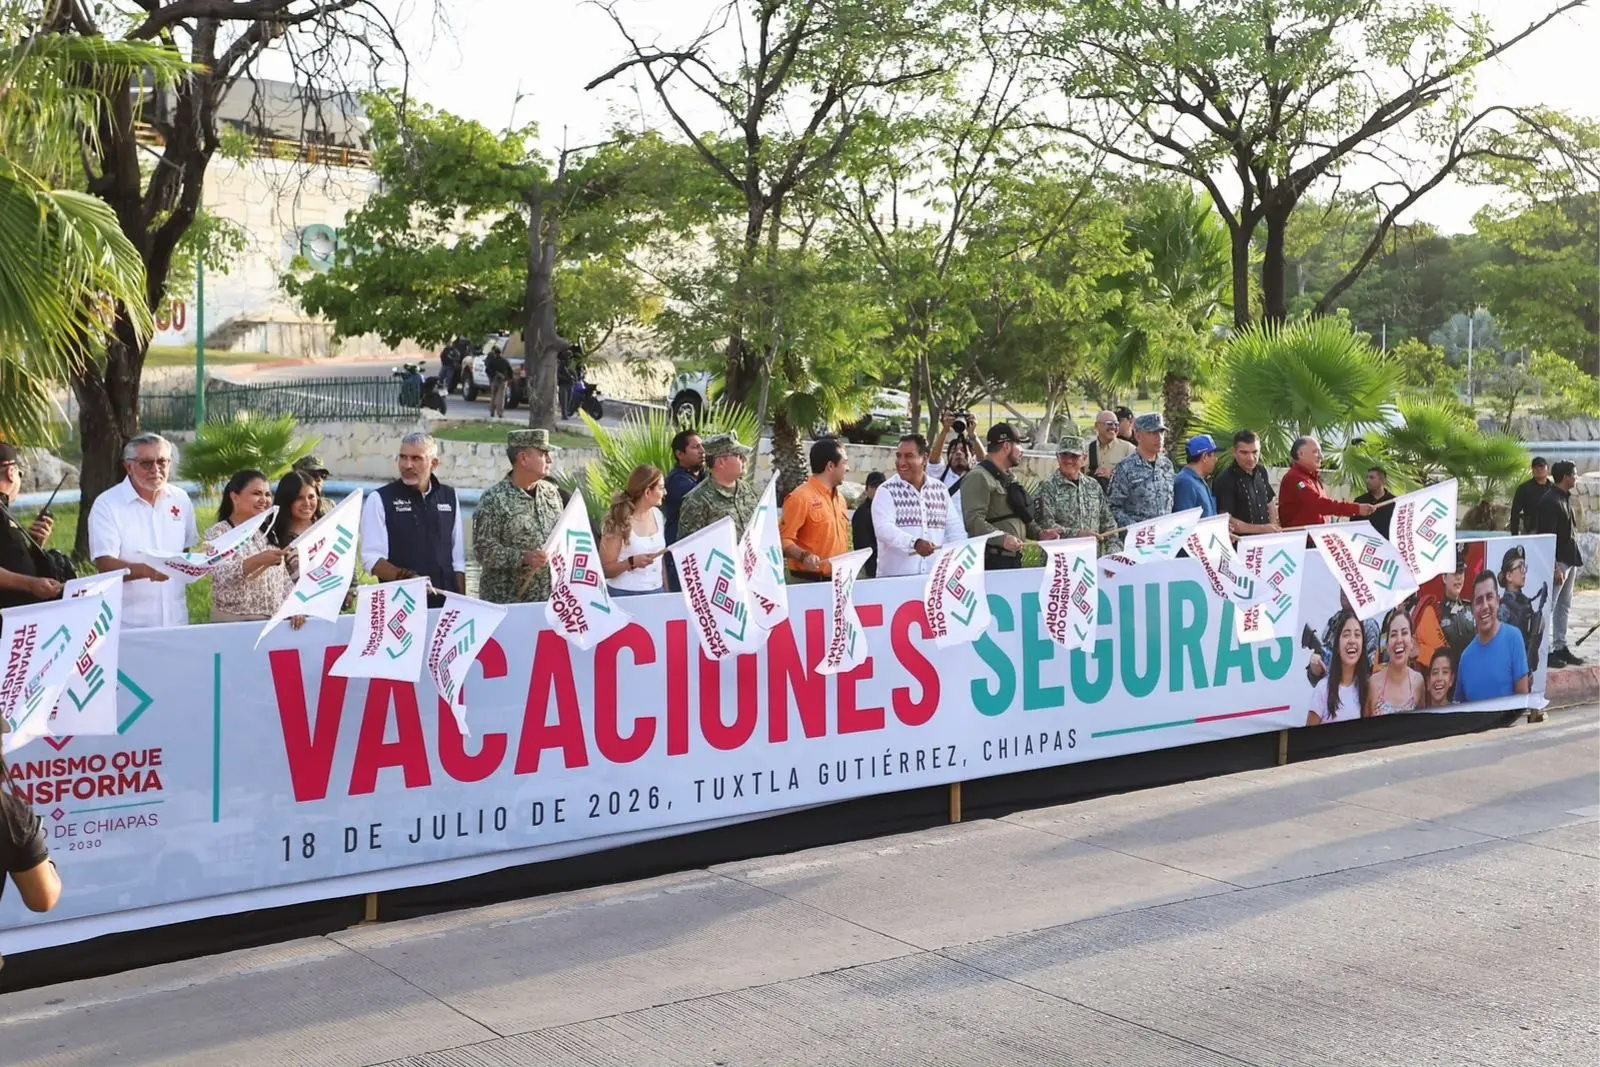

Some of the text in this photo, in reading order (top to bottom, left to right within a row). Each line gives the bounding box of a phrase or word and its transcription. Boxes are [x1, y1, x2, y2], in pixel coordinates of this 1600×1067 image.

[681, 553, 723, 660] TRANSFORMA
[687, 552, 731, 655] HUMANISMO QUE
[1046, 552, 1063, 638] TRANSFORM
[1321, 532, 1367, 607] TRANSFORMA
[1360, 583, 1376, 604] QUE
[572, 606, 589, 634] QUE
[936, 612, 948, 638] QUE
[5, 623, 37, 719] HUMANISMO
[268, 599, 941, 803] VACACIONES
[111, 748, 163, 773] QUE
[282, 728, 1077, 862] 18 DE JULIO DE 2026, TUXTLA GUTIÉRREZ, CHIAPAS
[54, 823, 78, 839] DE
[83, 813, 159, 835] CHIAPAS
[69, 839, 102, 851] 2030
